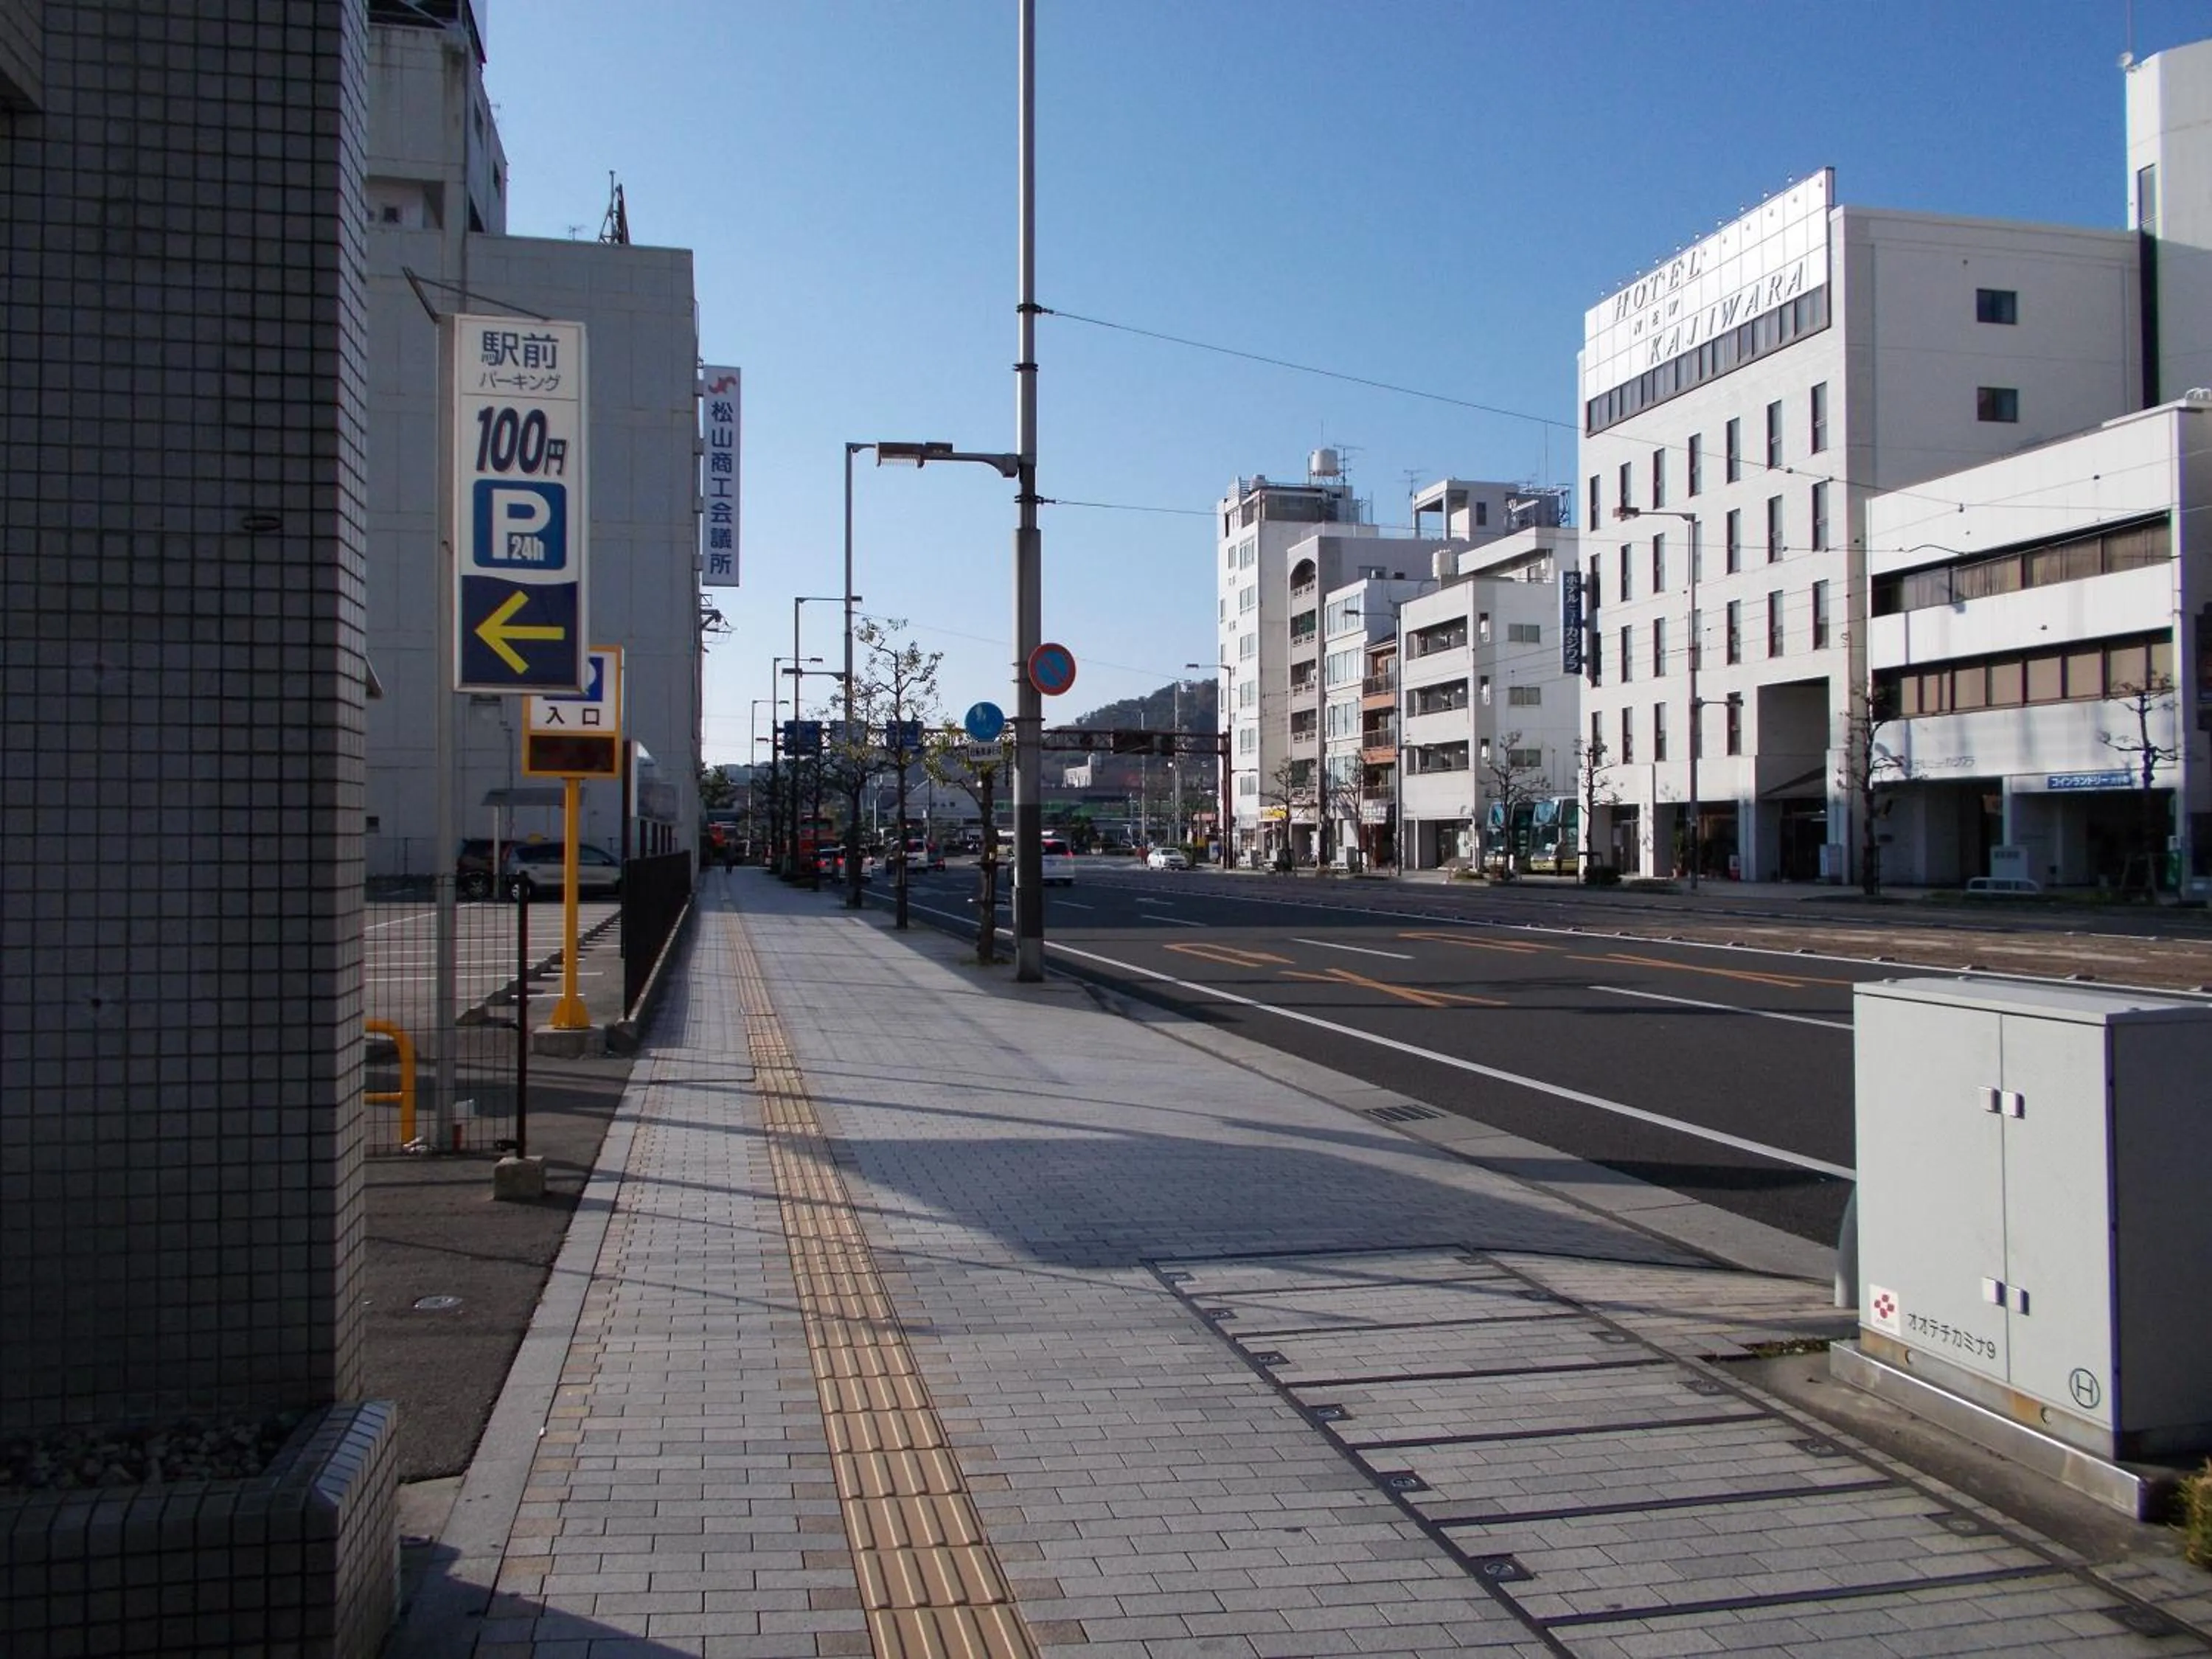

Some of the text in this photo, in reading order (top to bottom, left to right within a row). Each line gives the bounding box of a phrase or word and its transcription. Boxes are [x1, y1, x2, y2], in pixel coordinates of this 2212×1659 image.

[1614, 251, 1701, 321] HOTEL
[1633, 299, 1679, 335] NEW
[1650, 261, 1804, 364] KAJIWARA
[481, 331, 559, 369] 駅前
[479, 371, 561, 392] パーキング
[476, 406, 567, 476] 100円
[710, 401, 733, 574] 松山商工会議所
[493, 489, 551, 559] P
[511, 535, 545, 560] 24h
[546, 706, 600, 726] 入口
[1907, 1313, 1996, 1359] オオテチカミナ9
